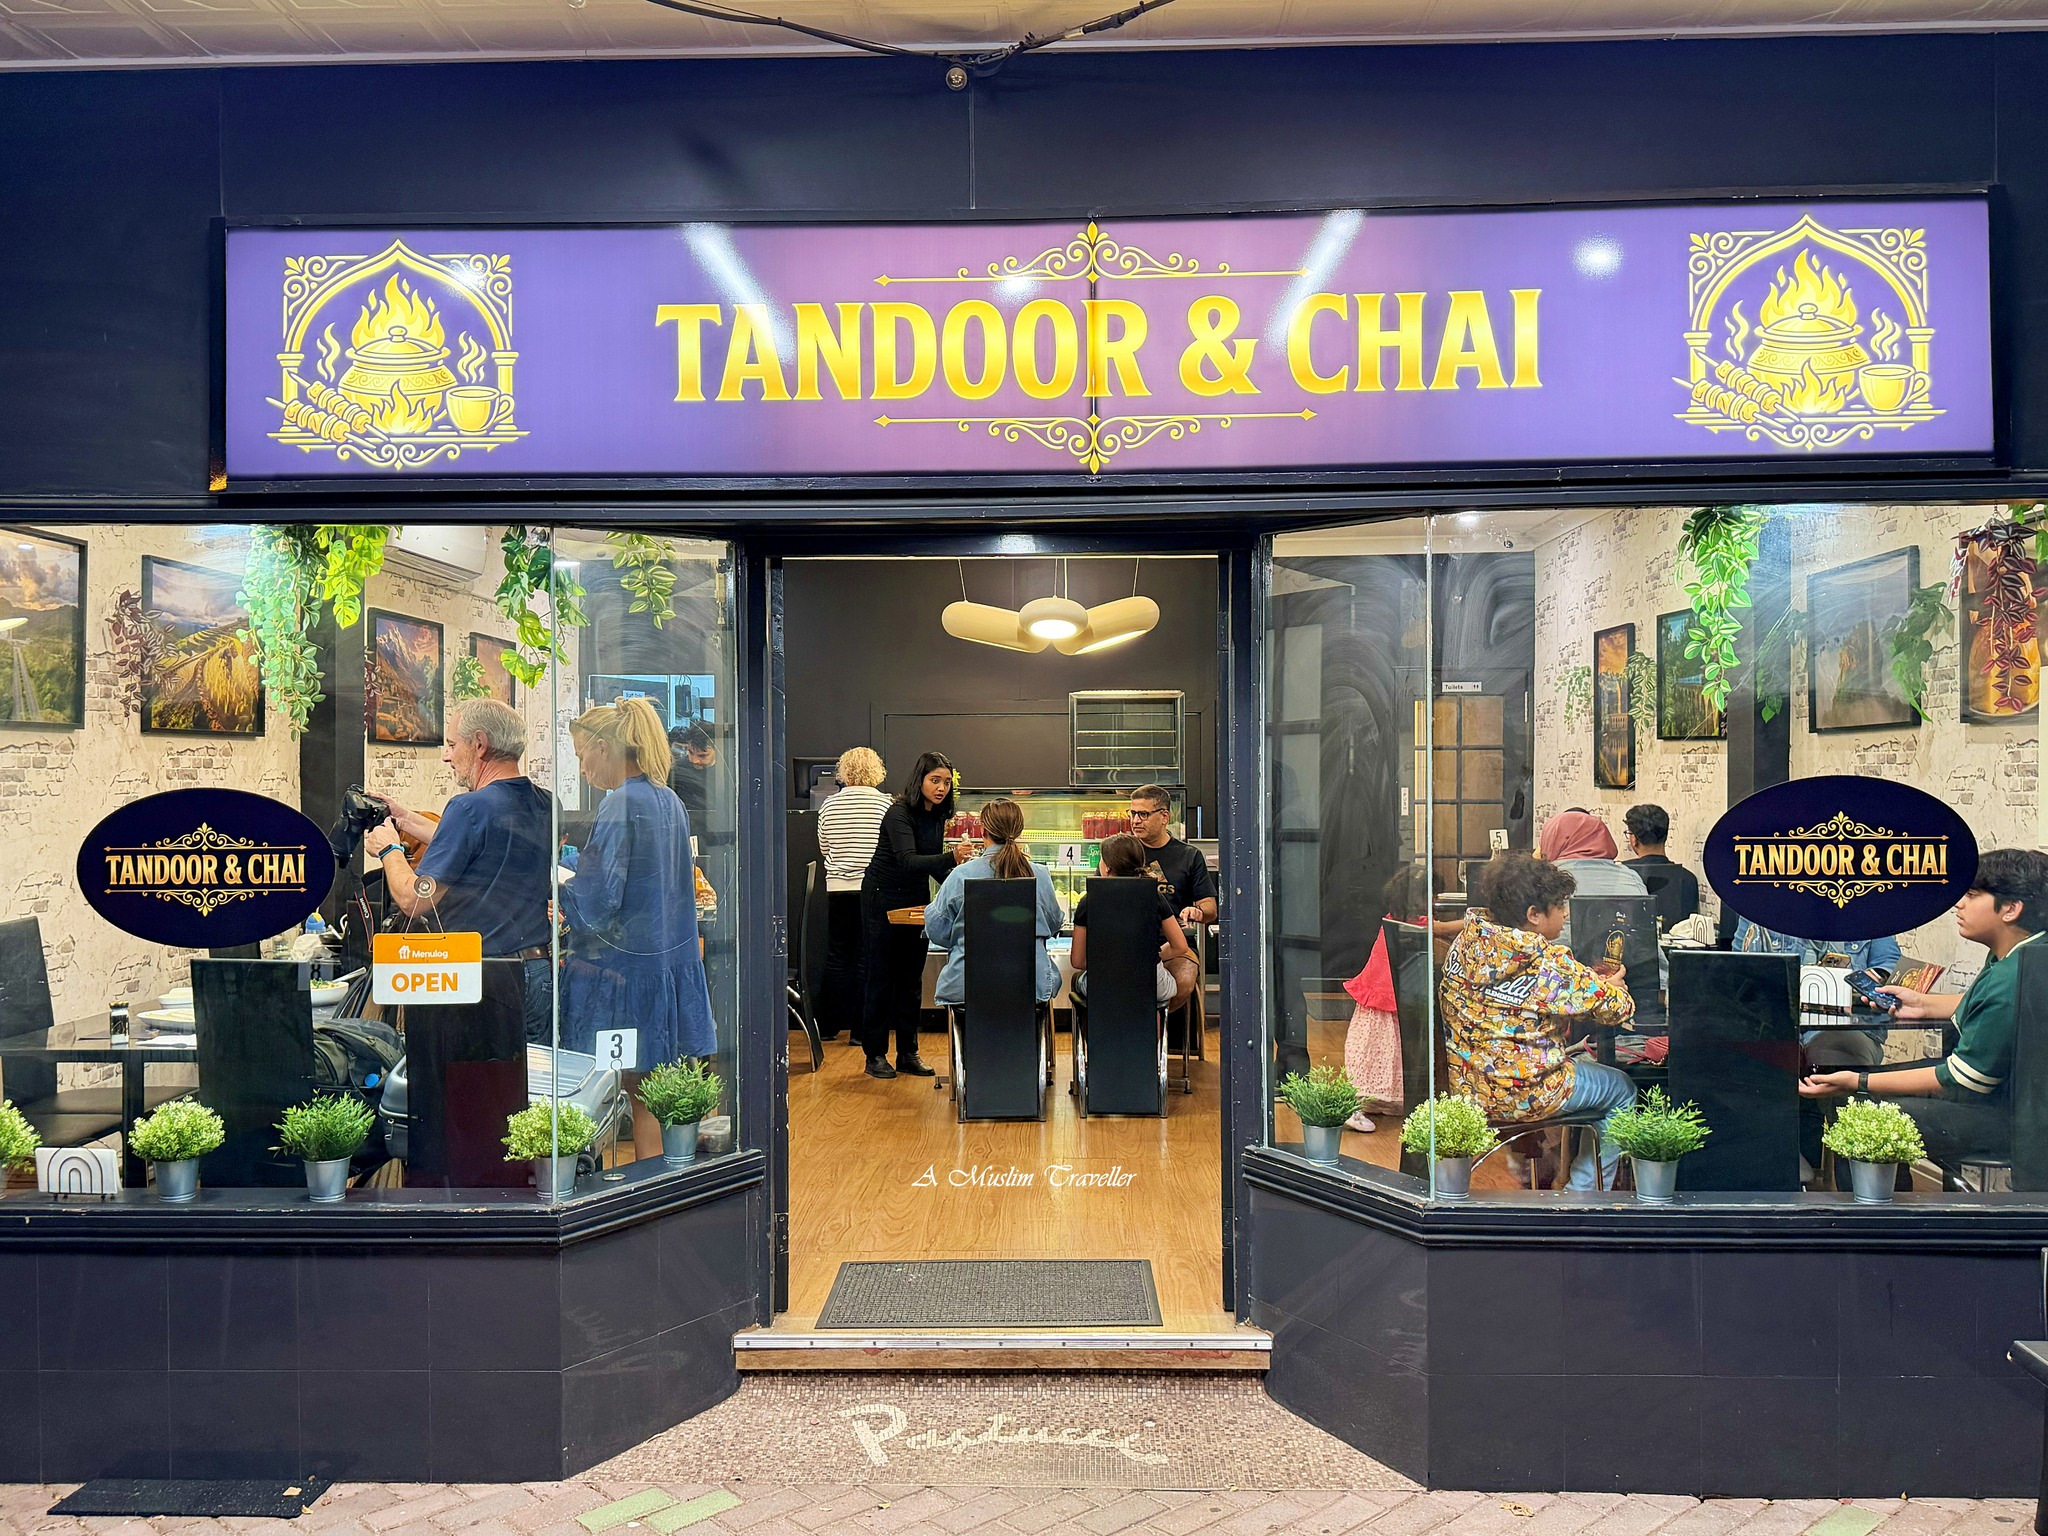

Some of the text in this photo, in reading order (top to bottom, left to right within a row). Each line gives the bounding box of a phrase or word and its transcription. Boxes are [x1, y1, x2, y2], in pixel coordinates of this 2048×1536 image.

[656, 288, 1543, 402] TANDOOR & CHAI
[1066, 846, 1074, 860] 4
[1734, 844, 1948, 876] TANDOOR & CHAI
[105, 853, 306, 885] TANDOOR & CHAI
[359, 897, 370, 919] Canon
[412, 948, 449, 960] Menulog
[391, 972, 459, 993] OPEN
[610, 1033, 623, 1059] 3
